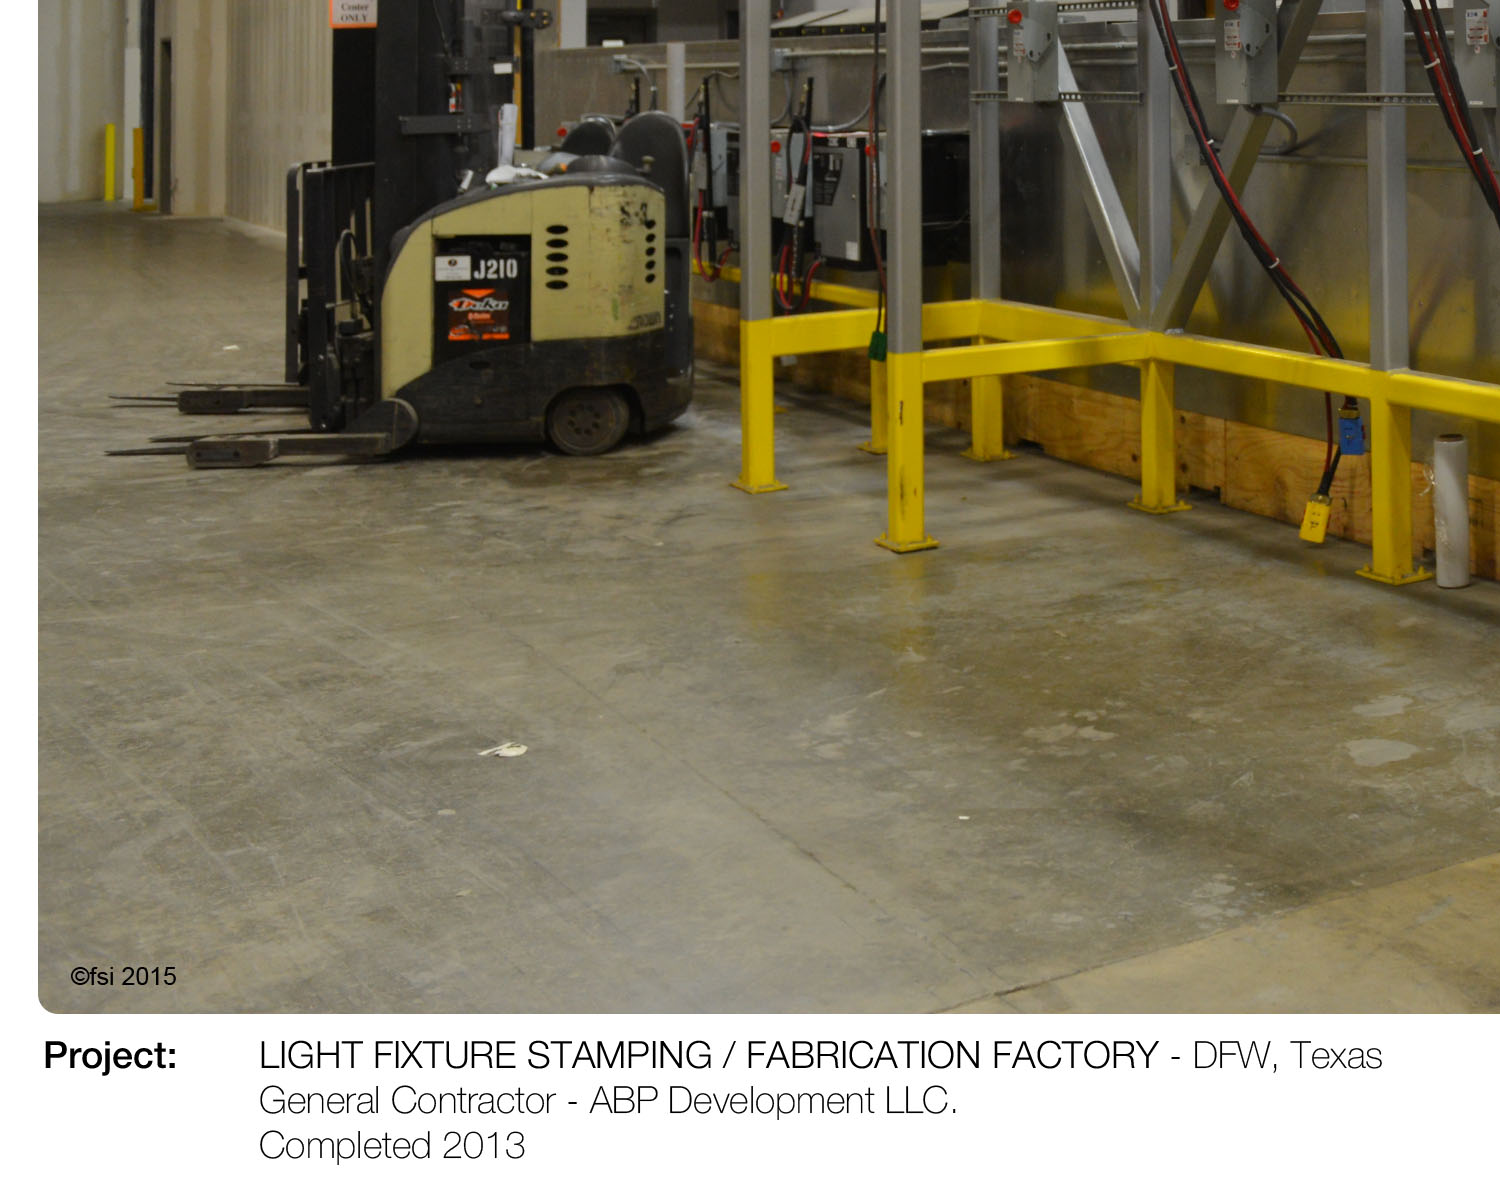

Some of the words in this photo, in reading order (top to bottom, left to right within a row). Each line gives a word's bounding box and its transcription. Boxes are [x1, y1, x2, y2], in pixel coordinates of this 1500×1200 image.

[341, 3, 368, 11] Center
[341, 14, 368, 22] ONLY
[473, 258, 518, 279] J210
